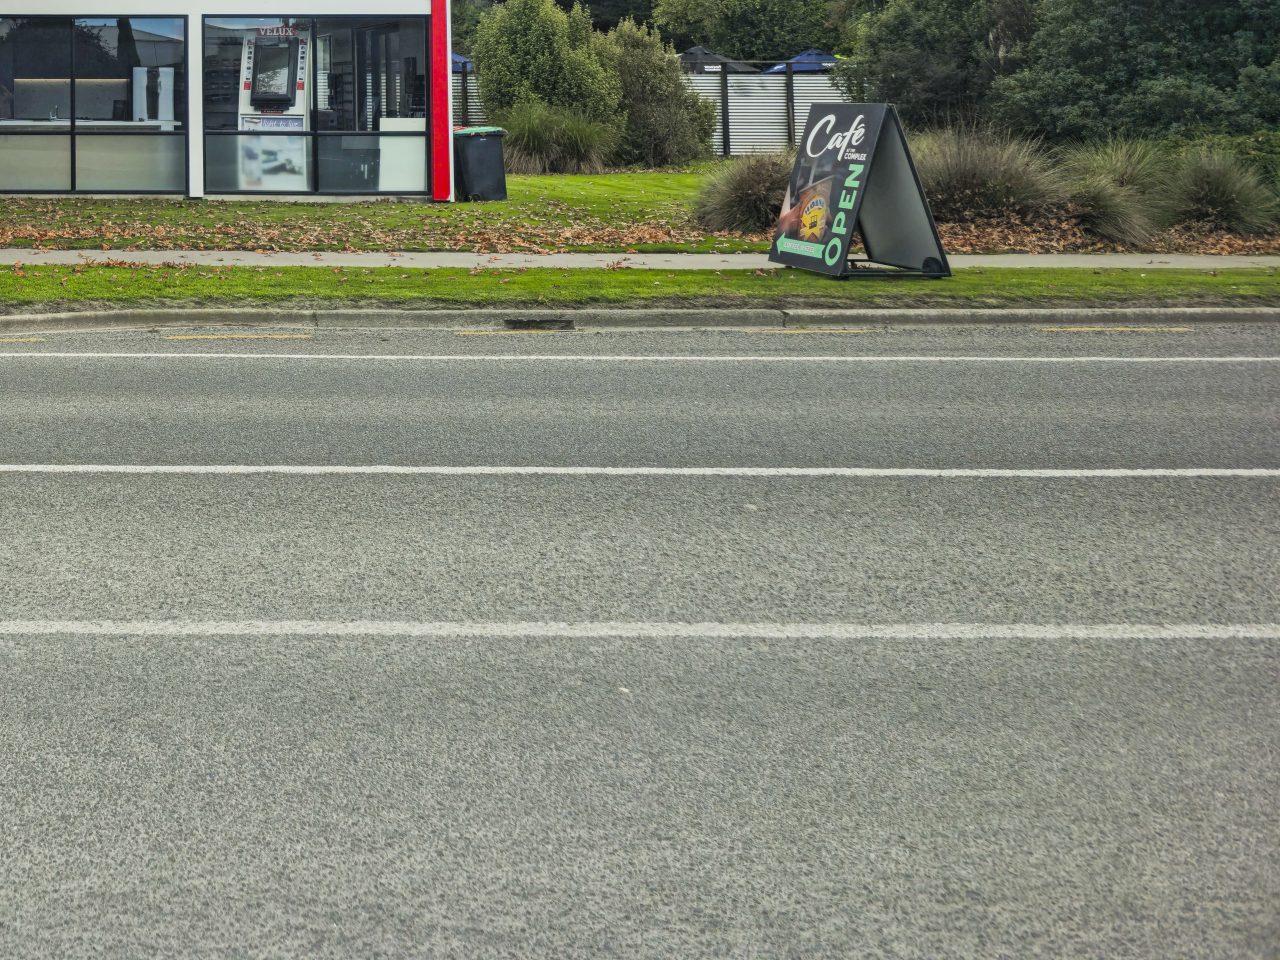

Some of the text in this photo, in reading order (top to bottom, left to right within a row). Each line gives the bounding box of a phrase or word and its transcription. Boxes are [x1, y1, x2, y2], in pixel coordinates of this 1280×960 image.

[259, 27, 294, 36] VELUX
[844, 152, 868, 161] COMPLEX
[825, 163, 865, 266] OPEN
